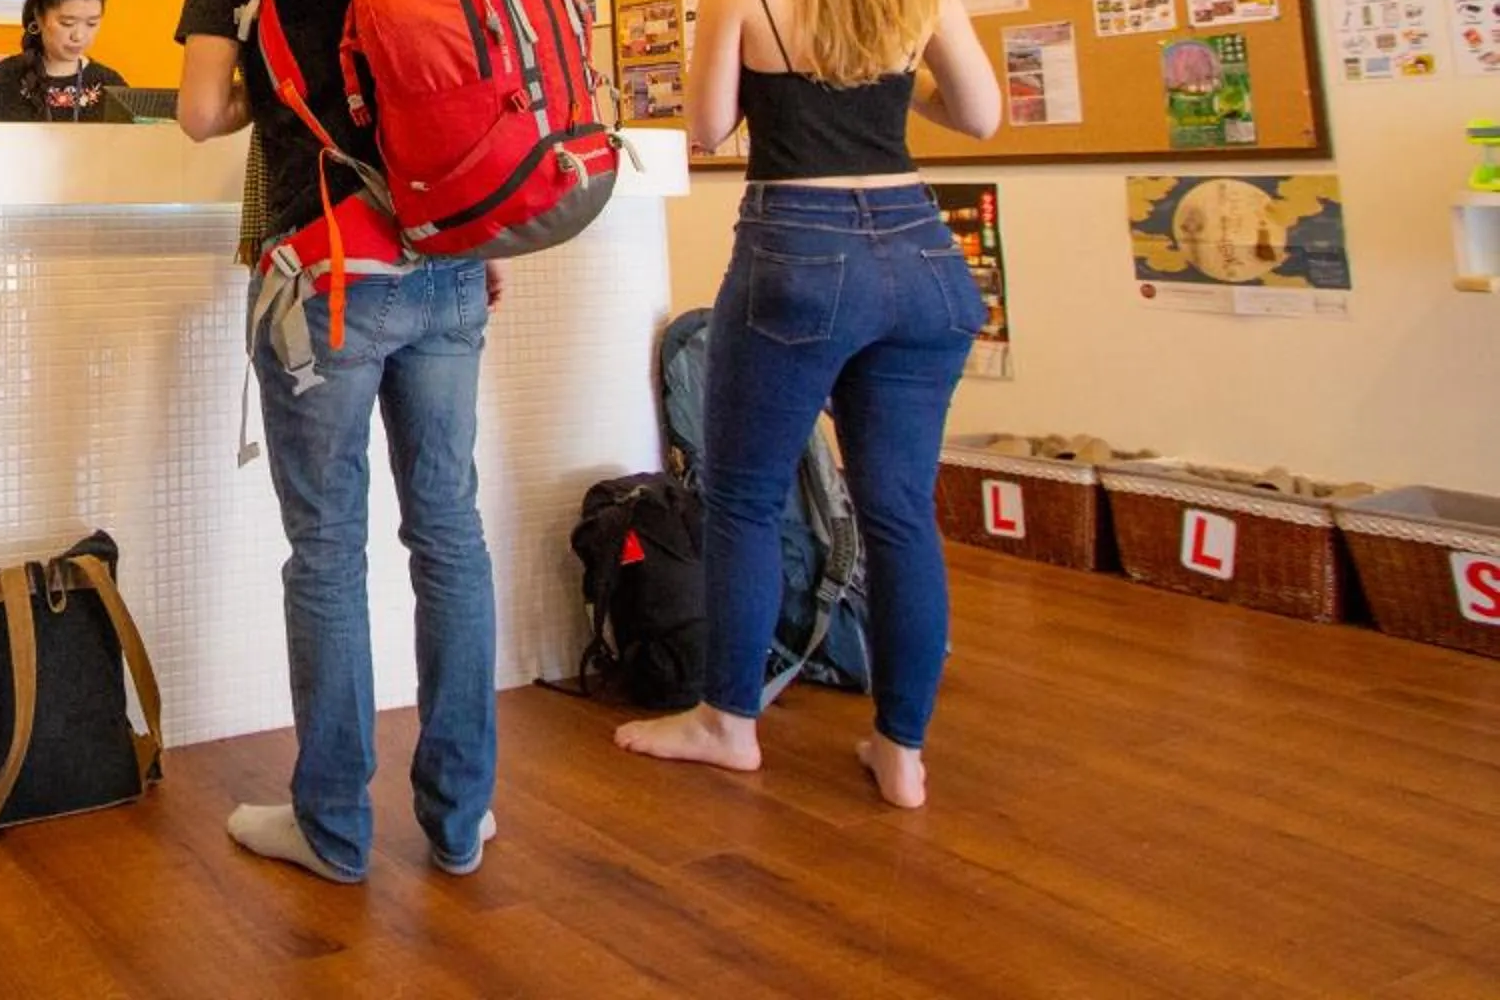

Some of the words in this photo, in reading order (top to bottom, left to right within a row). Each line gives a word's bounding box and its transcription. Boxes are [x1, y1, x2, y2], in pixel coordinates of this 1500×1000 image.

[990, 485, 1016, 531] L
[1191, 515, 1222, 570] L
[1465, 560, 1500, 618] S
